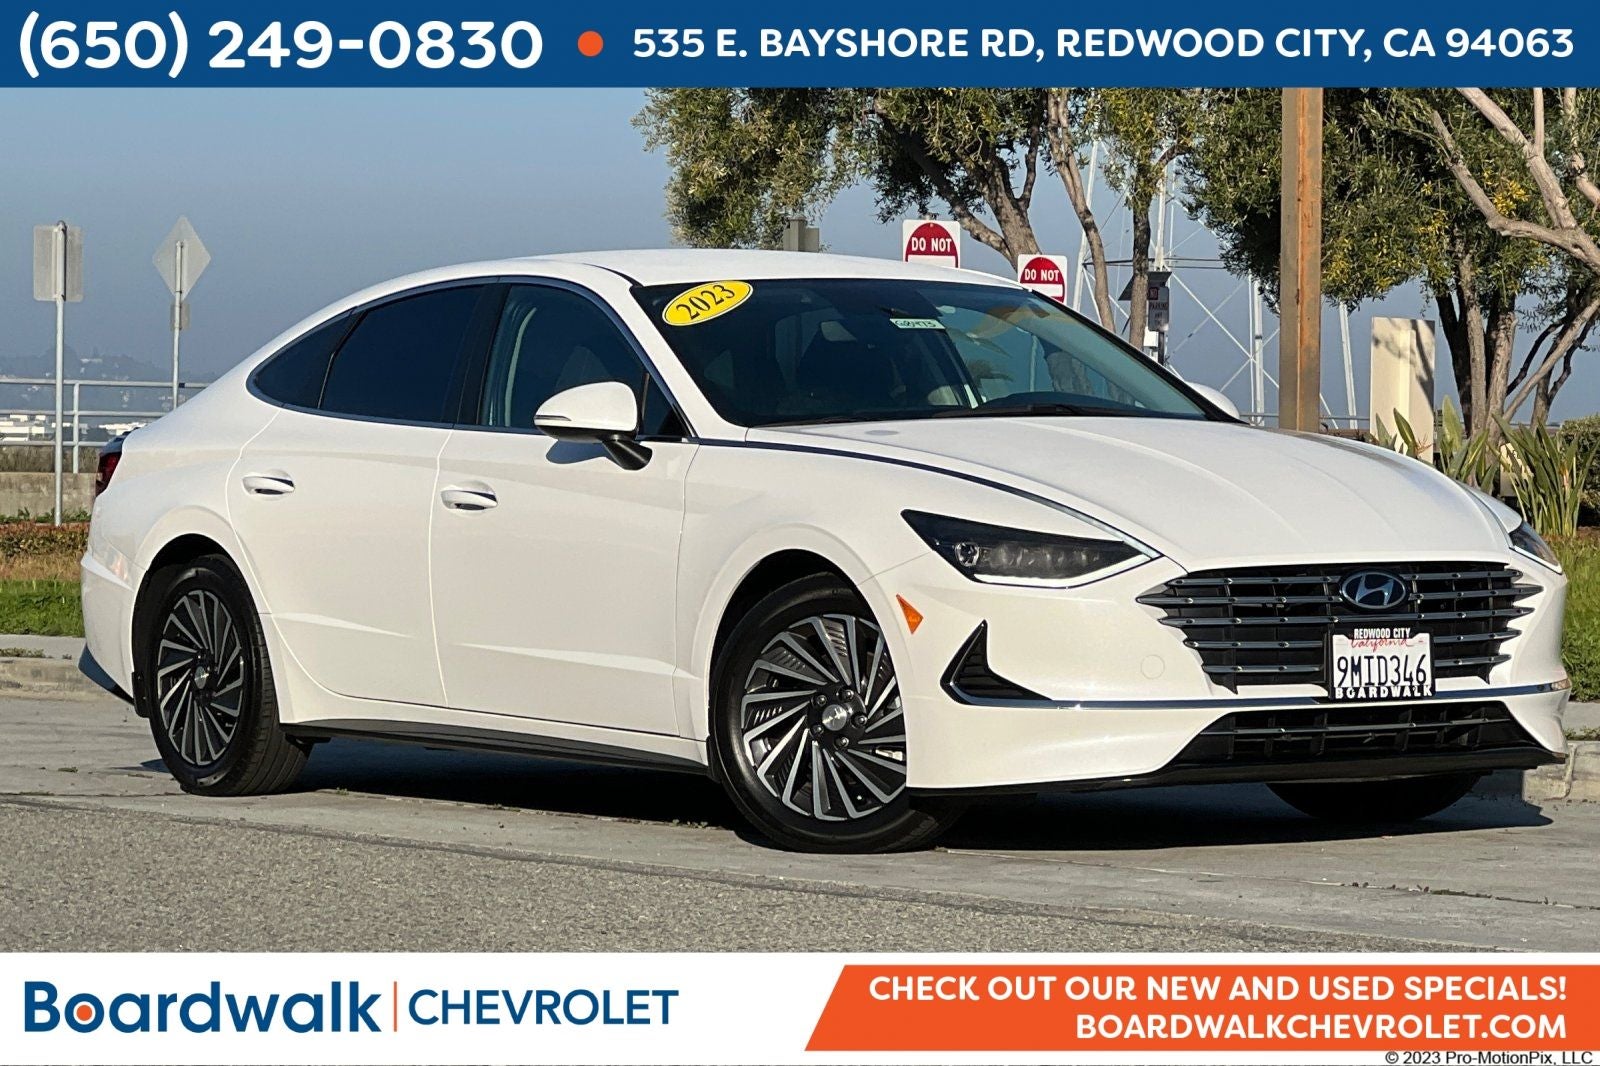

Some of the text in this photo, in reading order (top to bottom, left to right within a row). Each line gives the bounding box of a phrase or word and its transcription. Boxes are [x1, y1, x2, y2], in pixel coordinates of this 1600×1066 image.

[911, 237, 952, 252] DO NOT
[1024, 269, 1059, 281] DO NOT
[676, 285, 735, 320] 2023
[1353, 628, 1411, 639] REDWOOD CITY
[1337, 654, 1427, 687] 9MID346
[1335, 685, 1432, 699] BOARDWALK
